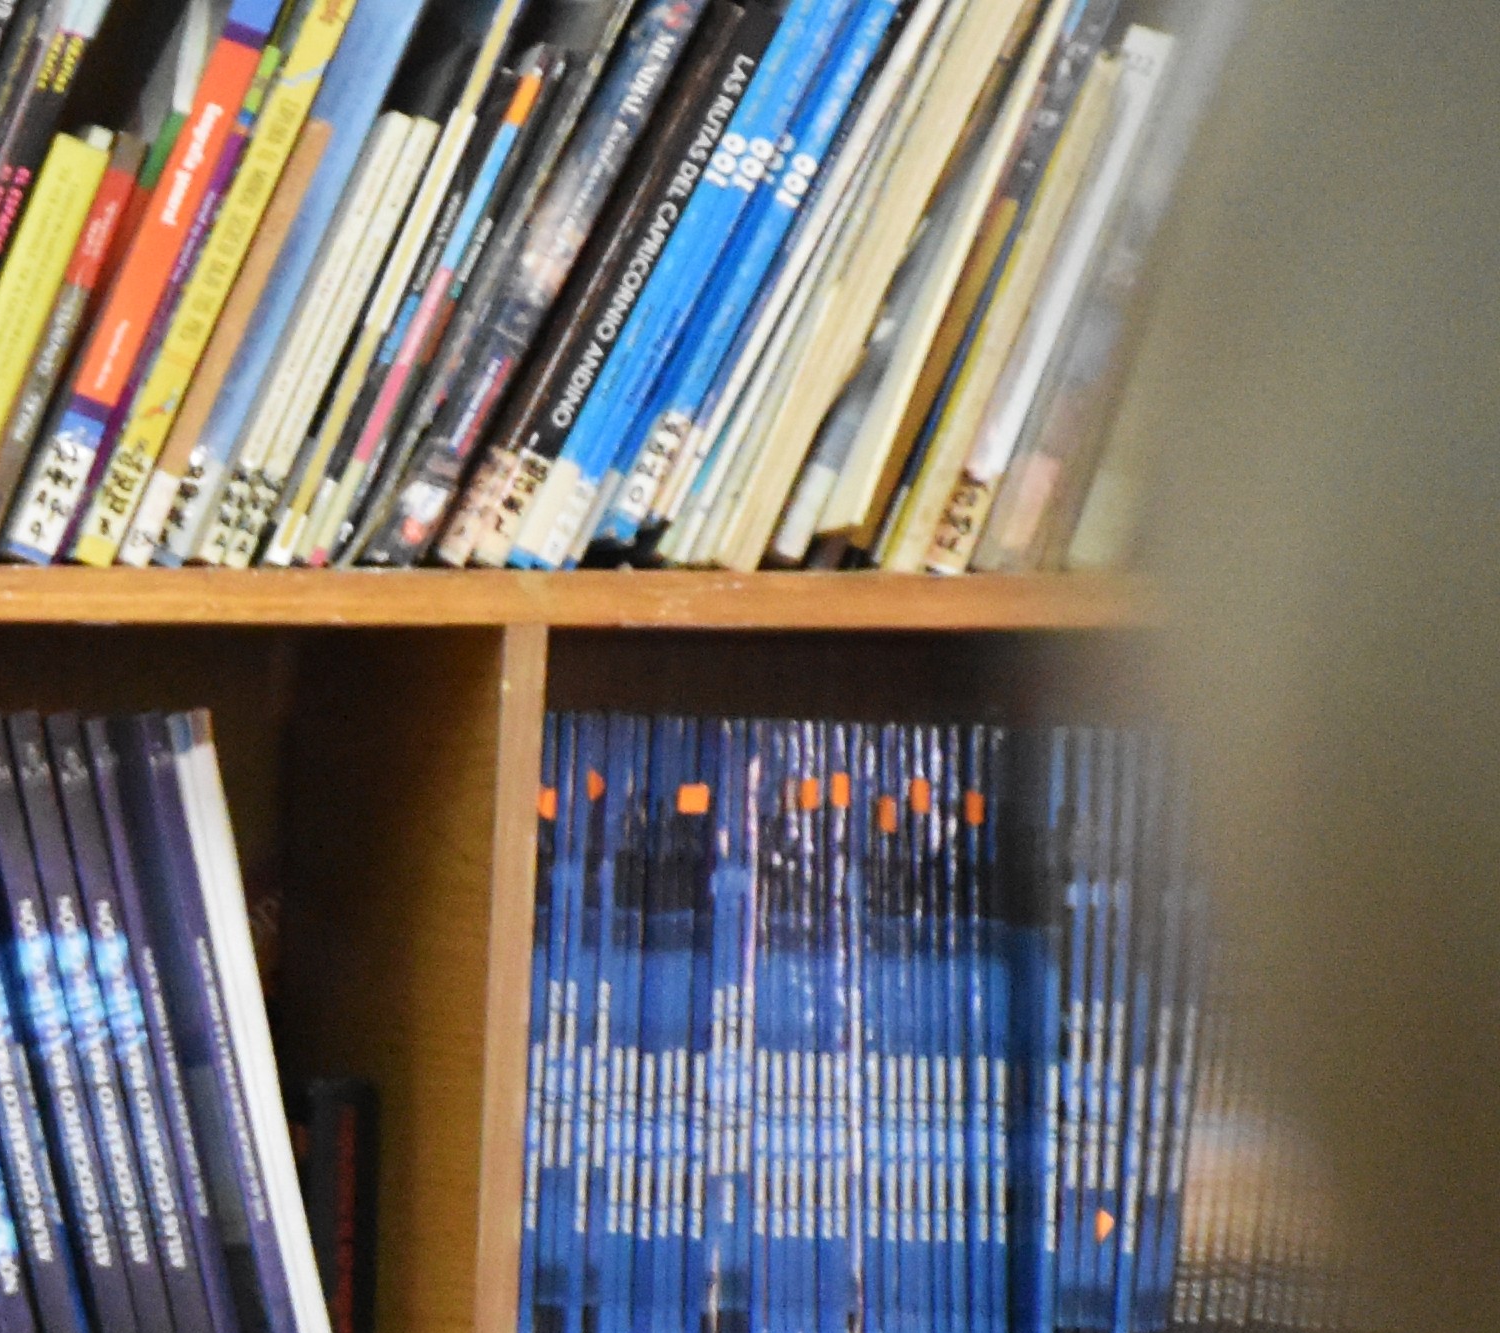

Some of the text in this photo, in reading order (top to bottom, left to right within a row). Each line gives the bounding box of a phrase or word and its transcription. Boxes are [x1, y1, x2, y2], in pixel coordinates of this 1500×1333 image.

[719, 51, 756, 96] LAS
[686, 92, 736, 162] RUTAS
[665, 159, 700, 202] DEL
[699, 128, 752, 188] 100
[728, 133, 778, 193] 100
[770, 148, 825, 211] 100
[592, 198, 680, 342] CAPRICORNIO
[547, 339, 607, 430] ANDINO
[159, 1213, 190, 1269] ATLAS
